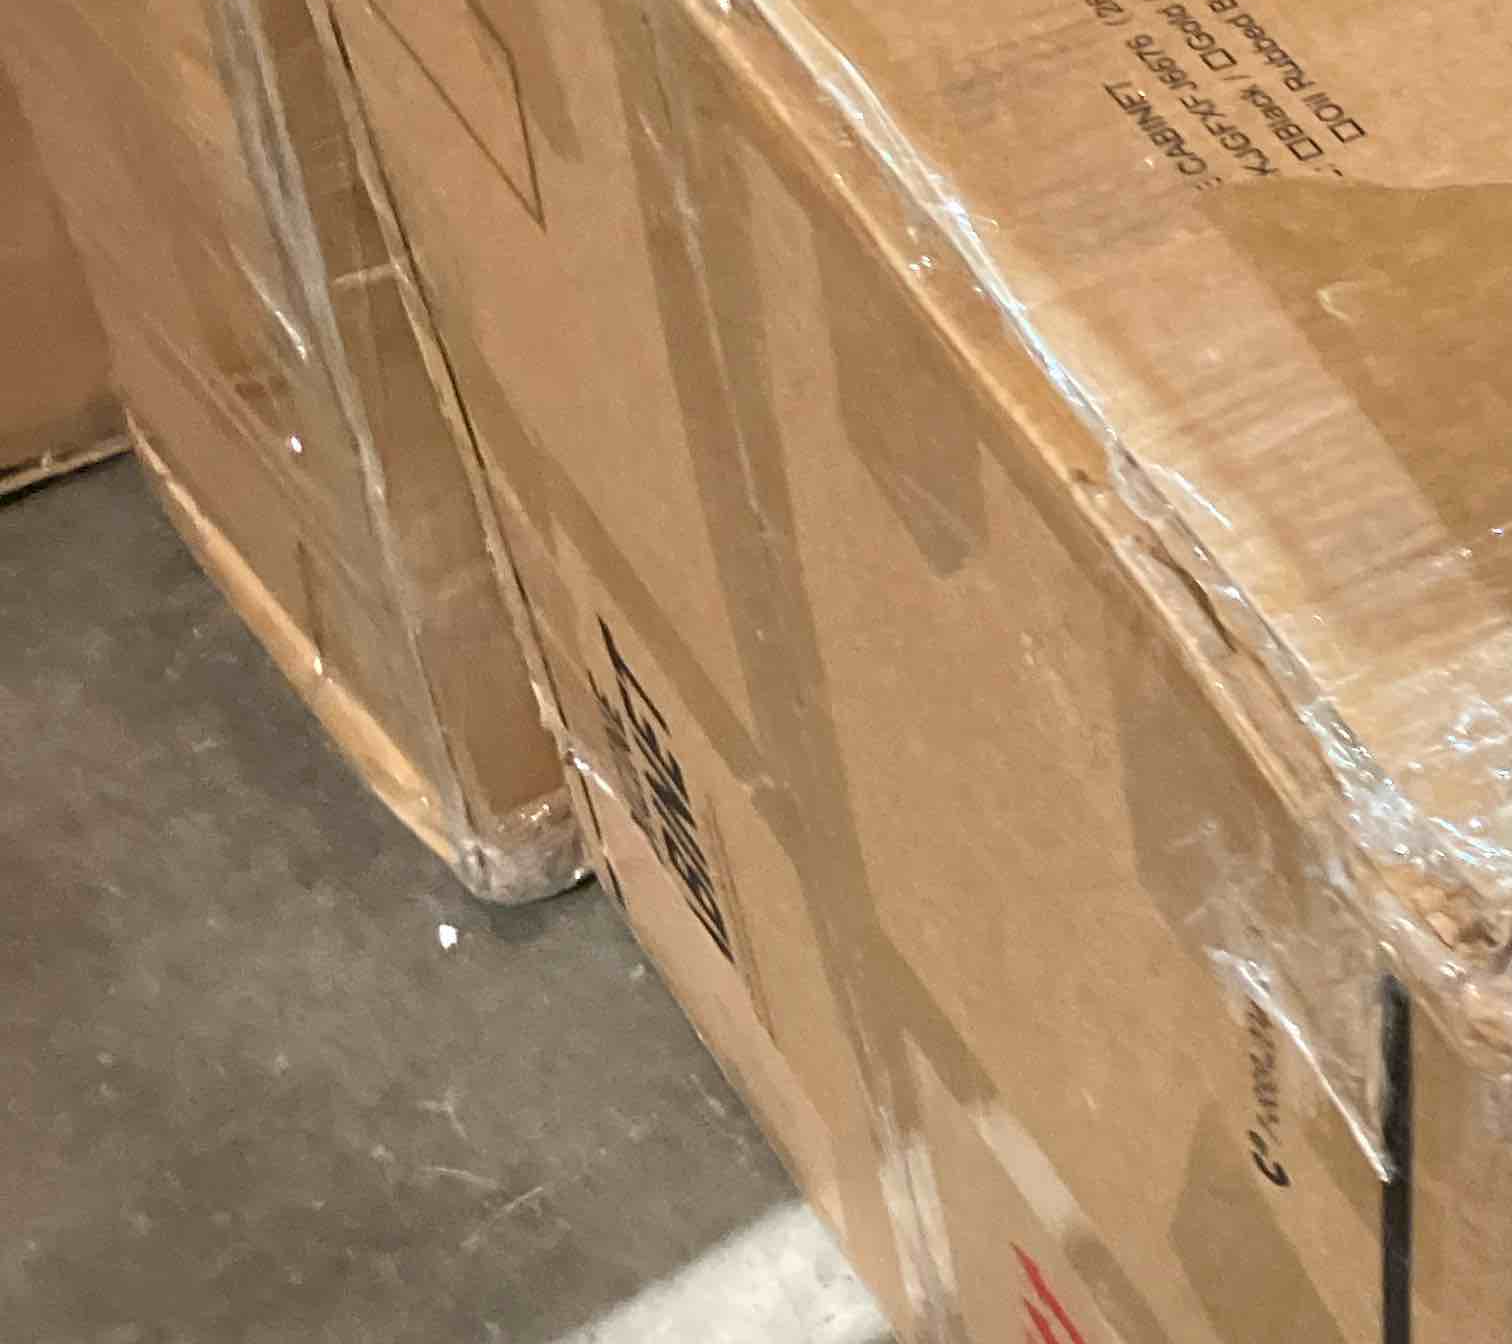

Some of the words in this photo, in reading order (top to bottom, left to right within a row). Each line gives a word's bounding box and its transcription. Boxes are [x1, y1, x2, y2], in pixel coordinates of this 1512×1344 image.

[1156, 3, 1216, 52] Gold
[1226, 13, 1316, 93] Rubbed
[1103, 81, 1208, 176] CABINET
